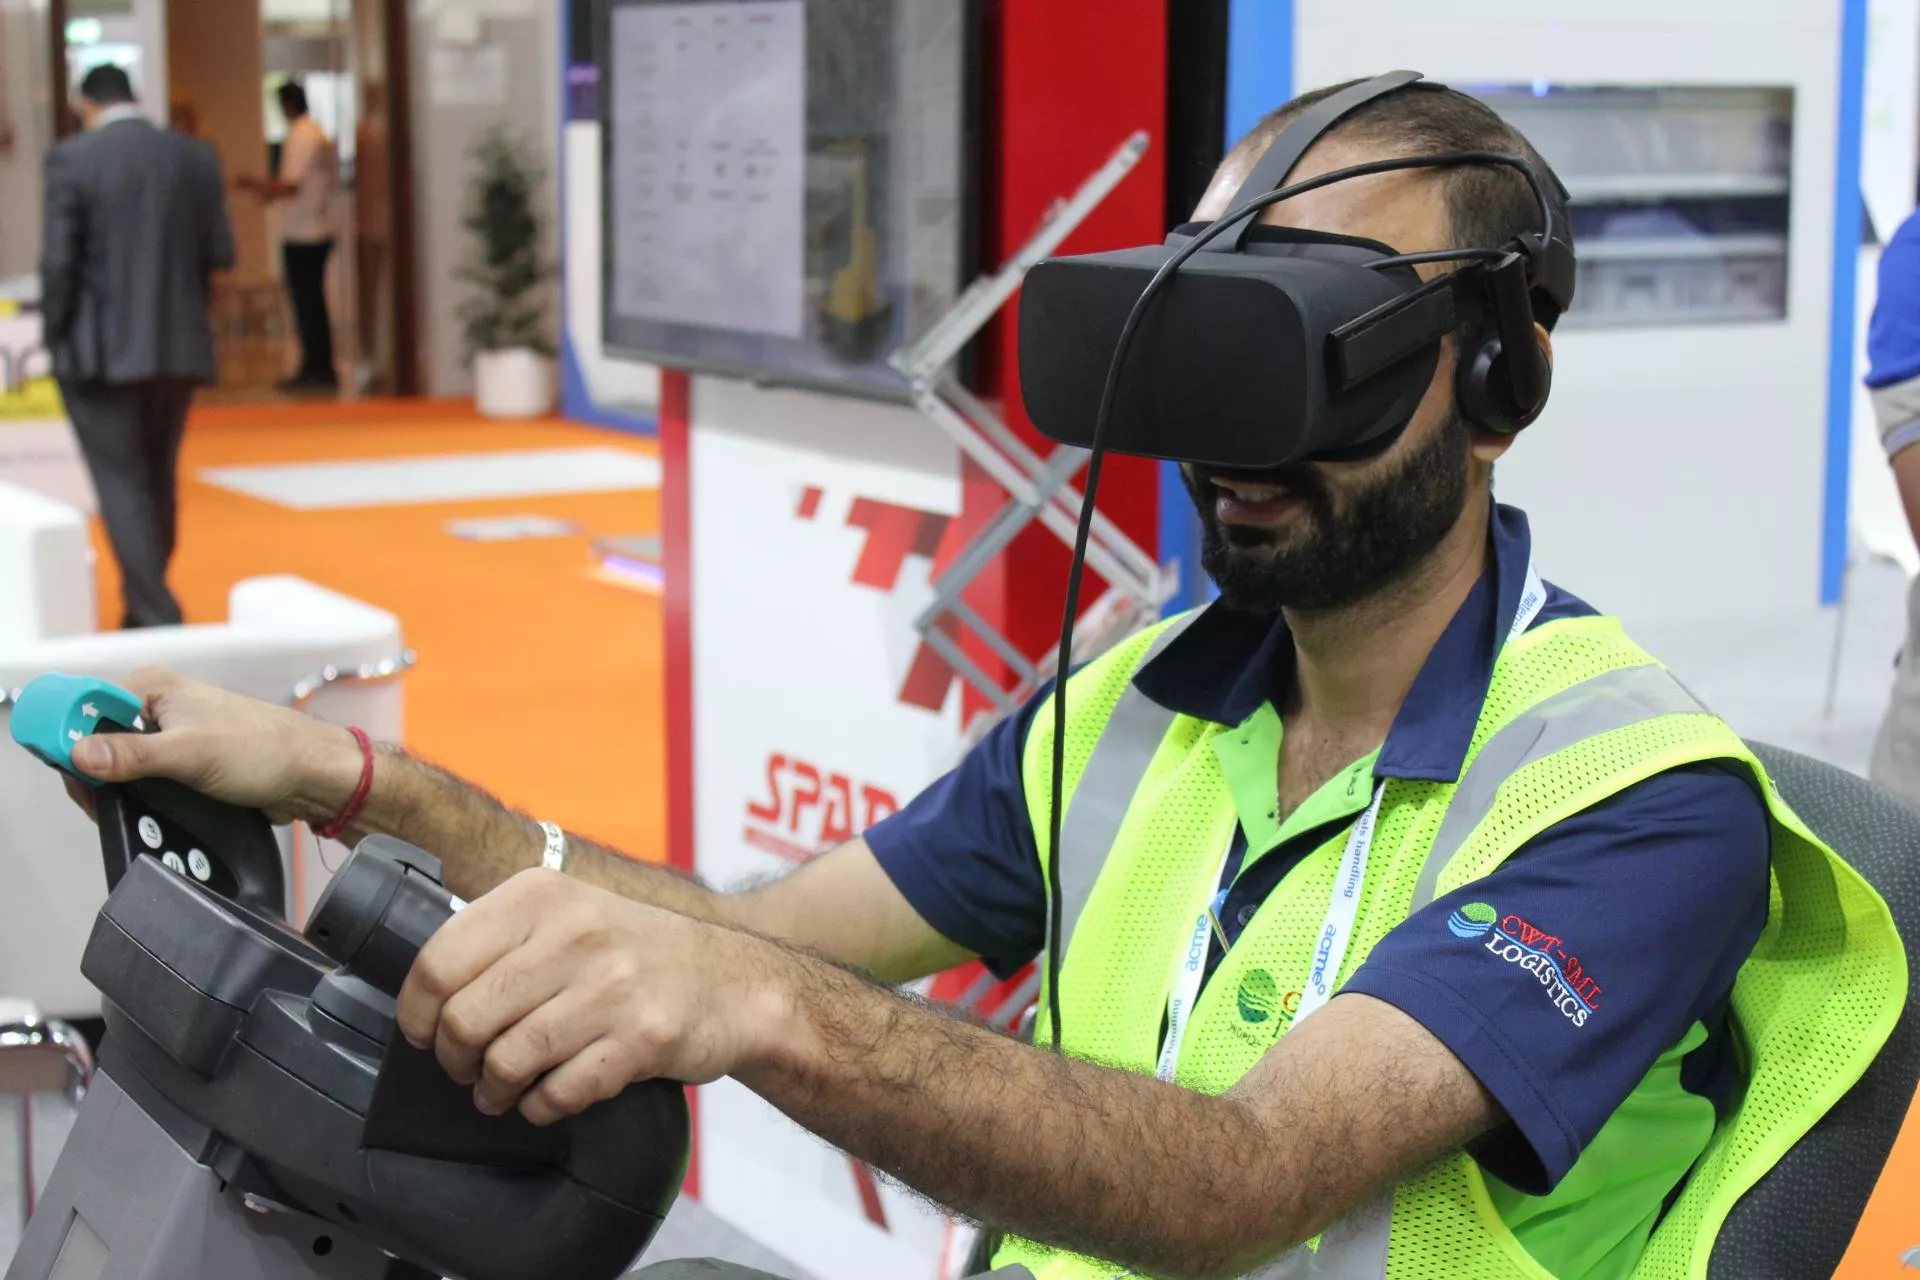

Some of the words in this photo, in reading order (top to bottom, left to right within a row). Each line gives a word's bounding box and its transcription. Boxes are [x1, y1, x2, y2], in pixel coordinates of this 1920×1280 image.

[1343, 839, 1366, 899] handling
[1186, 913, 1208, 972] acme
[1485, 933, 1589, 1028] LOGISTICS
